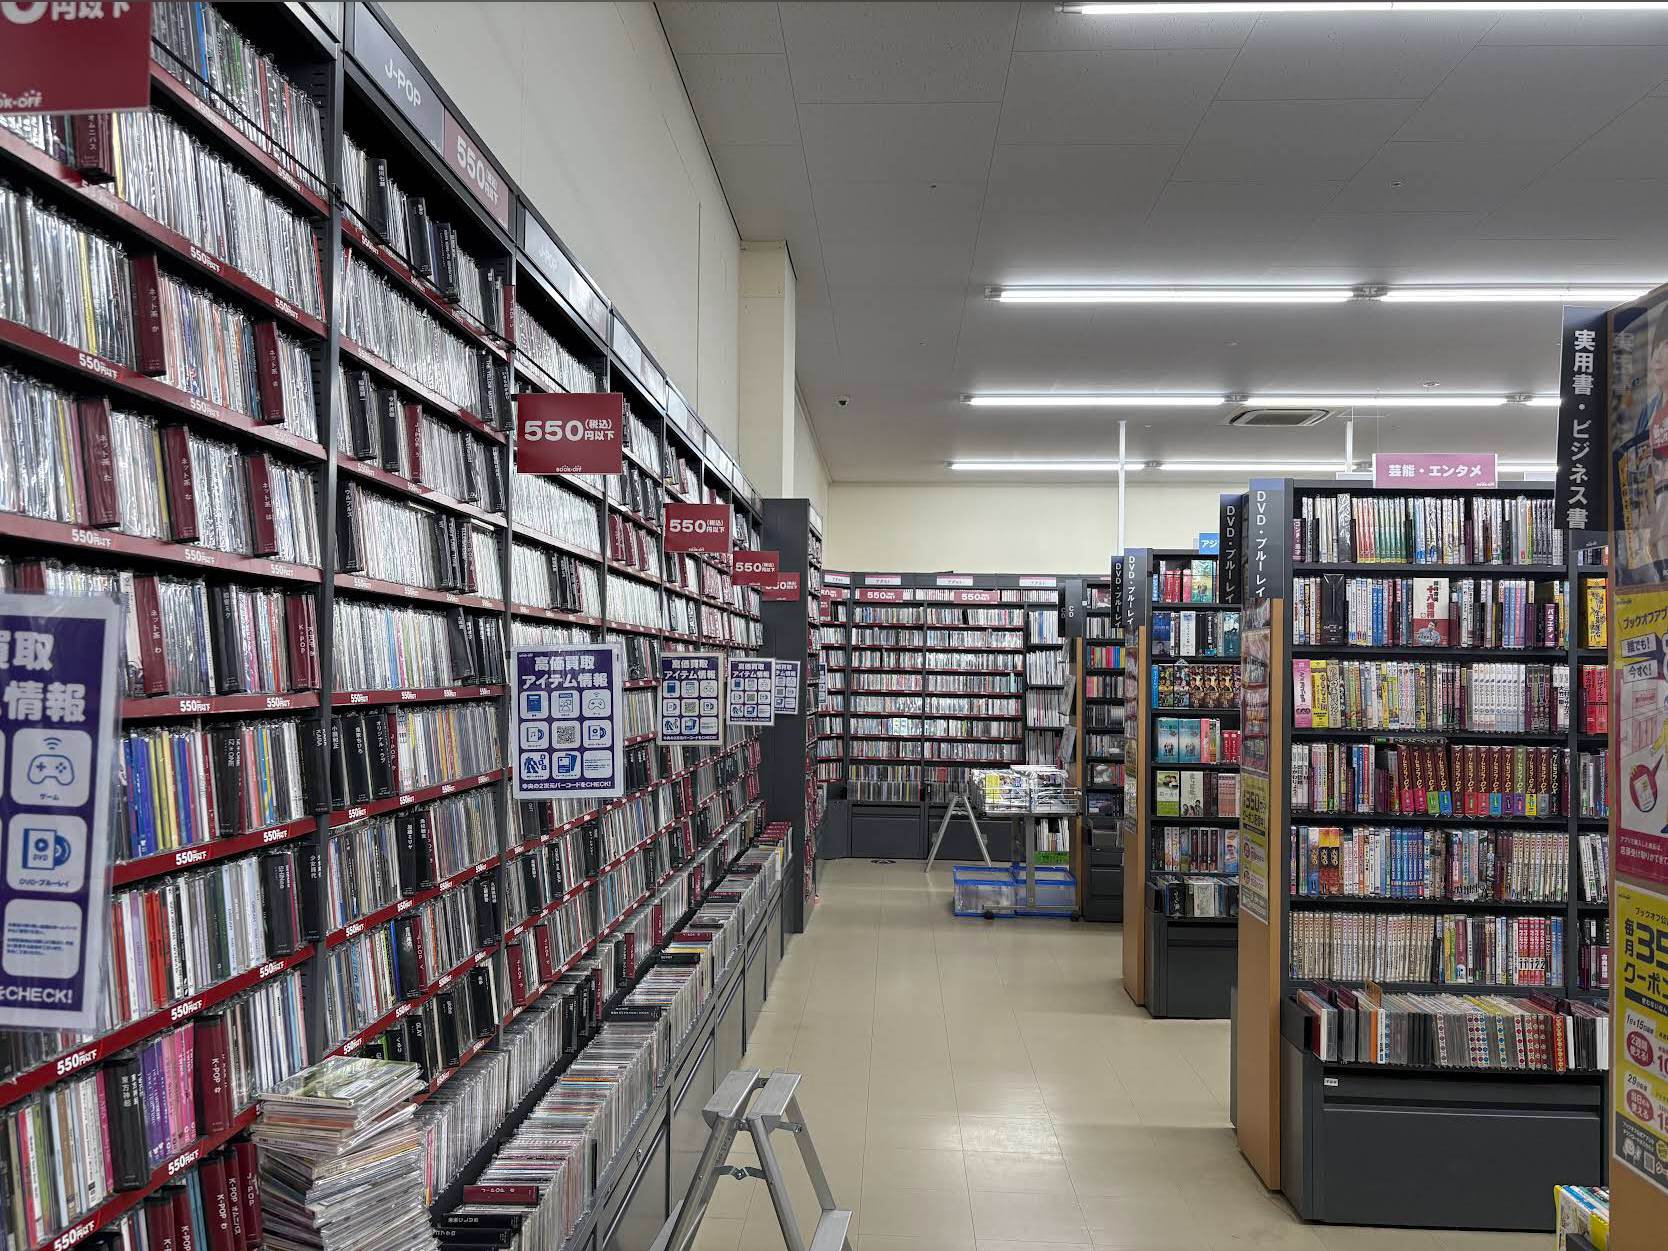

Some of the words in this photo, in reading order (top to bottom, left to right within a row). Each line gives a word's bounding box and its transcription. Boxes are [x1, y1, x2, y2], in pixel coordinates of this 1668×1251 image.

[384, 58, 421, 106] J-POP
[457, 135, 485, 190] 550
[524, 421, 583, 441] 550
[585, 419, 612, 429] (税込)
[585, 431, 614, 441] 円以下
[1567, 330, 1596, 530] 実用書・ビジネス書
[1388, 464, 1482, 477] 芸能・エンタメ
[669, 520, 706, 533] 550
[1225, 506, 1236, 604] DVD・ブルーレイ
[1256, 492, 1267, 597] DVD・ブルーレイ
[736, 562, 762, 572] 550
[1127, 556, 1135, 625] DVD・ブルーレイ
[1547, 608, 1555, 638] バラエティ
[535, 656, 594, 671] 高価買取
[522, 673, 608, 689] アイテム情報
[4, 680, 86, 722] 情報
[1625, 918, 1634, 957] 毎月
[212, 1058, 221, 1083] K-POP
[229, 1178, 237, 1202] K-POP
[217, 1194, 226, 1219] K-POP
